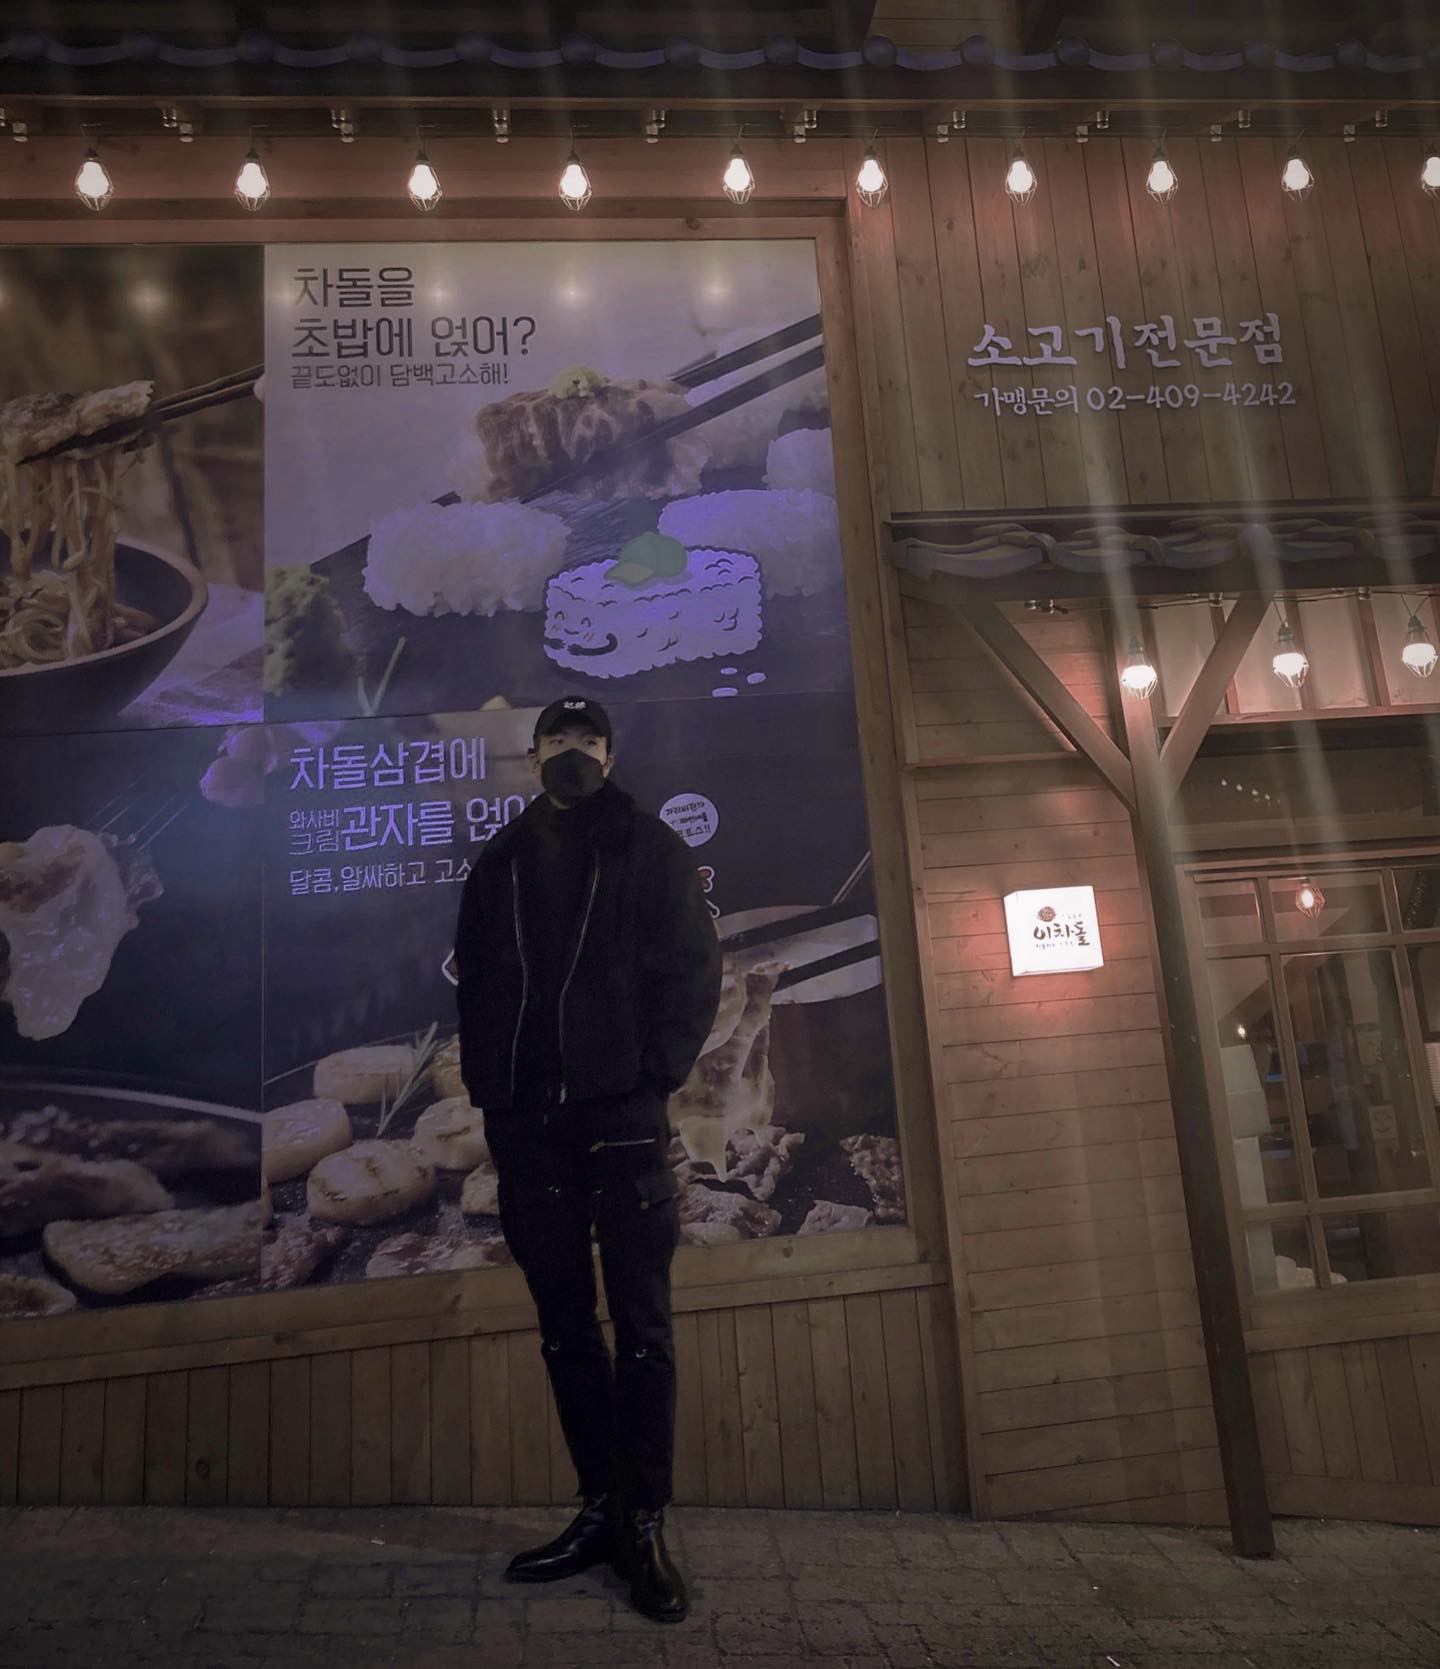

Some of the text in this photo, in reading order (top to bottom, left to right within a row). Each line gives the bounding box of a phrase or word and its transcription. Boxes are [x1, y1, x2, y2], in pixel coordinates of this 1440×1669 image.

[294, 266, 415, 308] 차돌을
[291, 316, 537, 359] 초밥에 얹어?
[967, 312, 1284, 369] 소고기전문점
[290, 362, 509, 390] 끝도없이 담백고소해!
[973, 381, 1297, 417] 가맹문의 02-409-4242
[288, 737, 487, 792] 차돌삼겹에
[289, 808, 340, 830] 와사비
[341, 799, 455, 851] 관자를
[288, 830, 340, 855] 크림
[1033, 921, 1091, 946] 이차돌
